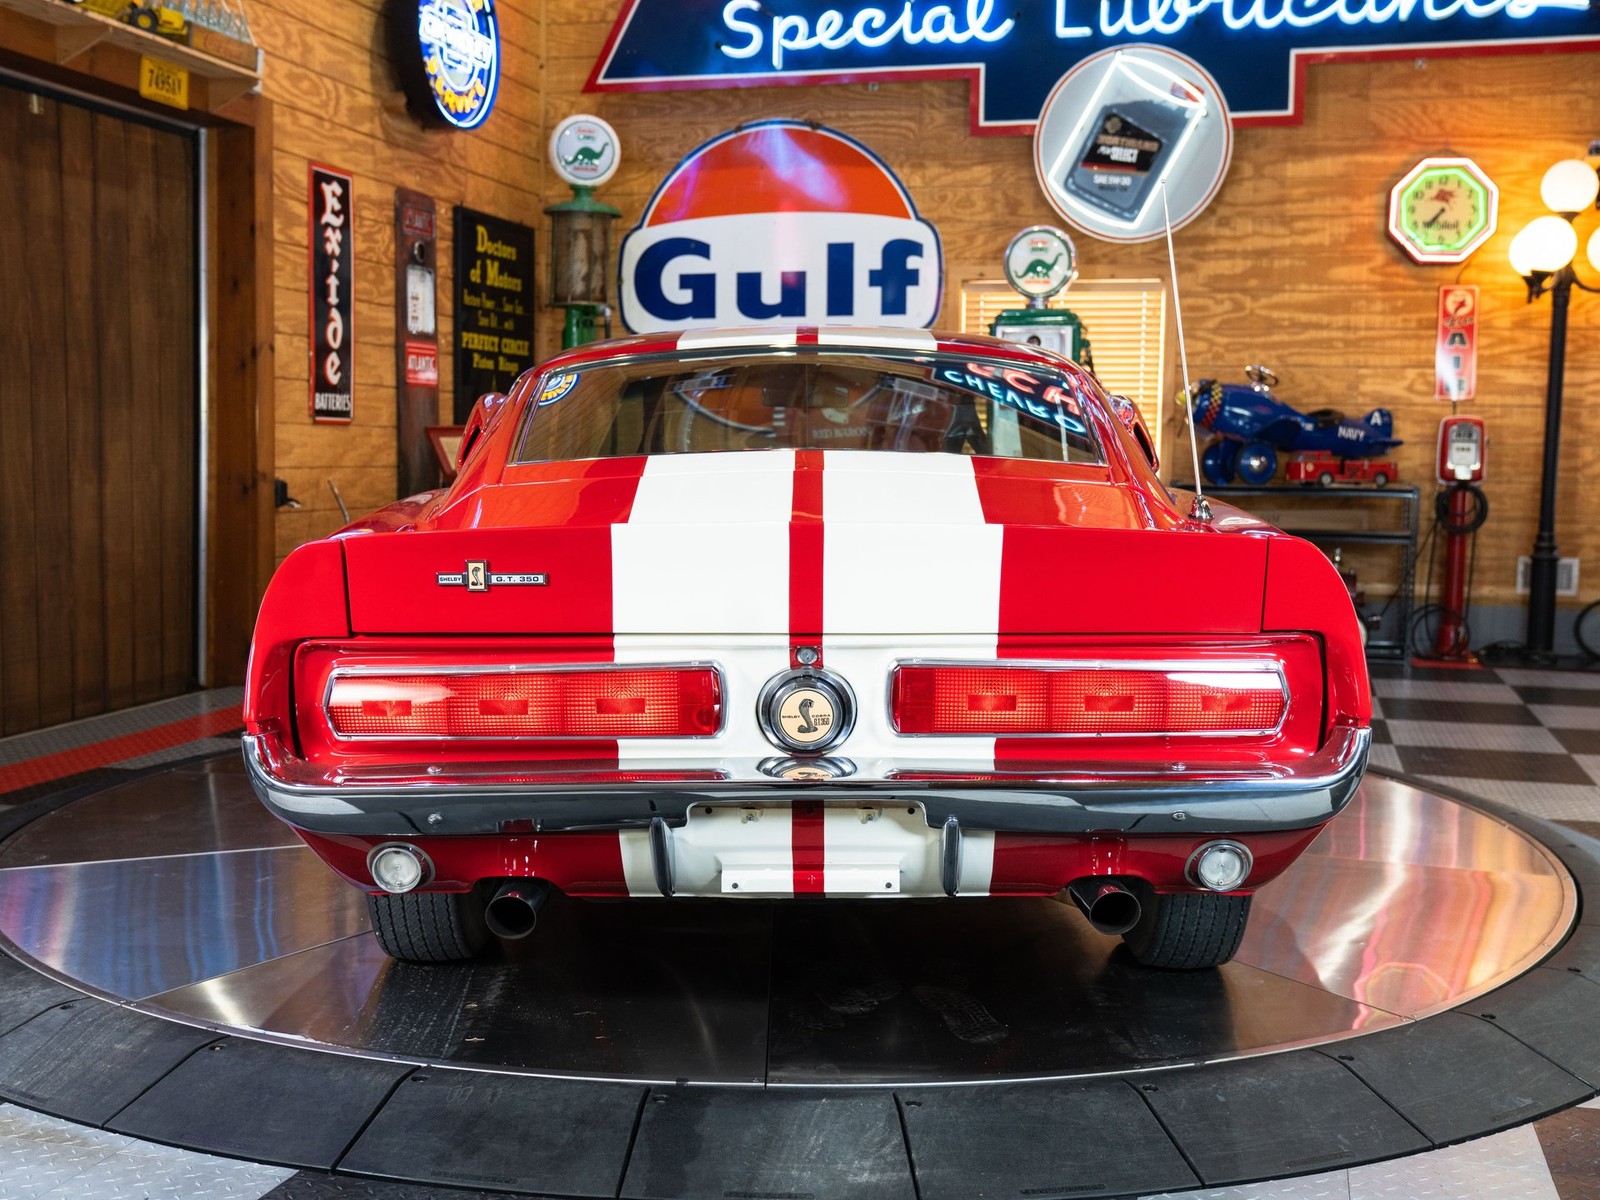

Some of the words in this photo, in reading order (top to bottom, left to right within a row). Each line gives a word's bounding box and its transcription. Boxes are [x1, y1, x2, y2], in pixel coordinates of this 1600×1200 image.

[720, 0, 1014, 70] Special
[476, 224, 517, 261] Doctors
[320, 180, 344, 386] Exide
[470, 259, 481, 283] of
[486, 259, 522, 292] Motors
[634, 237, 923, 321] Gulf
[462, 332, 499, 353] PERFECT
[501, 338, 530, 356] CIRCLE
[407, 354, 436, 372] ATLANTIC
[473, 353, 494, 371] Piston
[314, 392, 352, 411] BATTERIES
[1370, 411, 1383, 425] A
[1337, 426, 1366, 442] NAVY
